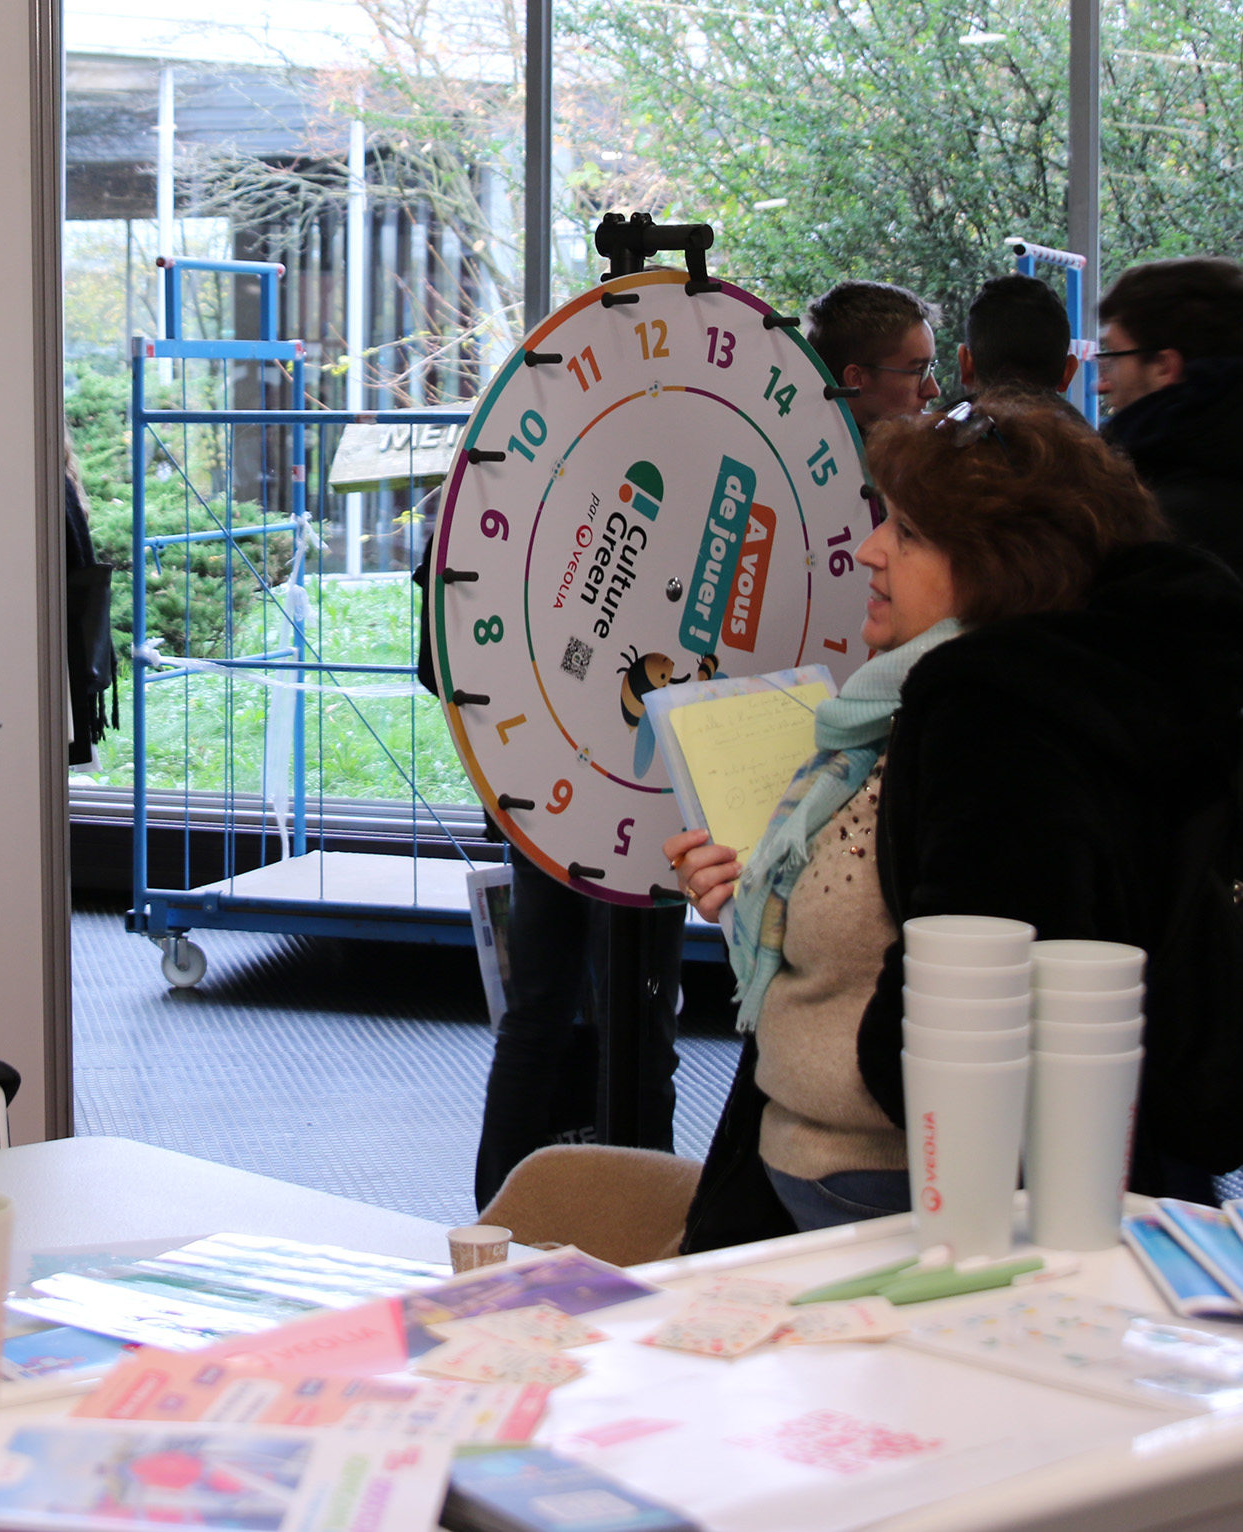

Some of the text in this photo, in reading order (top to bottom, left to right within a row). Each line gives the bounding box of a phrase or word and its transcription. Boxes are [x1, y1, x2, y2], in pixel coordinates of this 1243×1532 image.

[634, 319, 670, 361] 12
[707, 326, 736, 369] 13
[566, 346, 602, 392] 11
[763, 366, 798, 418] 14
[507, 409, 548, 463] 10
[806, 438, 839, 487] 15
[480, 509, 510, 542] 9
[553, 492, 600, 609] par VEOLIA
[580, 512, 628, 605] Green
[689, 475, 747, 643] de jouer !
[730, 514, 767, 635] A vous
[826, 526, 855, 578] 16
[593, 525, 648, 639] Culture
[473, 615, 504, 646] 8
[823, 638, 847, 654] 1
[495, 713, 527, 746] 7
[545, 778, 574, 815] 6
[613, 817, 635, 856] 5
[922, 1110, 938, 1183] VEOLIA
